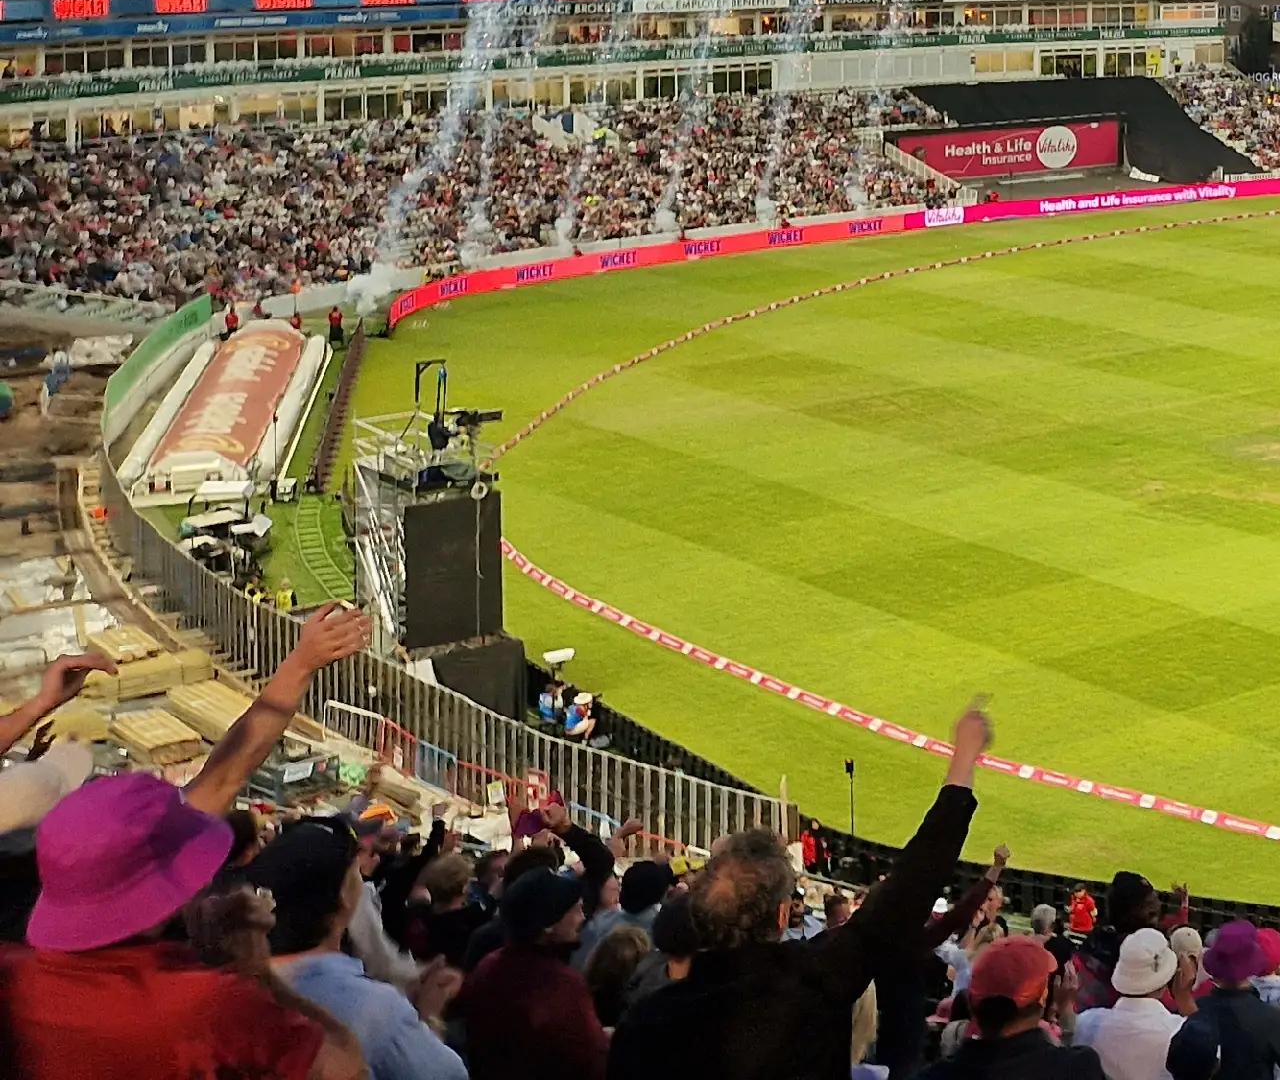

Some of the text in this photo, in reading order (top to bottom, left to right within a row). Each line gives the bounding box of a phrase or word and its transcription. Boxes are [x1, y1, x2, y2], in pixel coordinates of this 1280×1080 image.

[1248, 72, 1270, 81] HOG
[944, 137, 1032, 158] Health & Life
[1038, 134, 1077, 156] Vitality
[982, 152, 1032, 166] insurance
[1040, 184, 1237, 213] Health and Life insurance with Vitality
[926, 207, 962, 225] Vitality
[848, 219, 883, 234] WICKET
[768, 228, 804, 245] WICKET
[684, 239, 722, 256] WICKET
[600, 251, 638, 269] WICKET
[516, 263, 554, 282] WICKET
